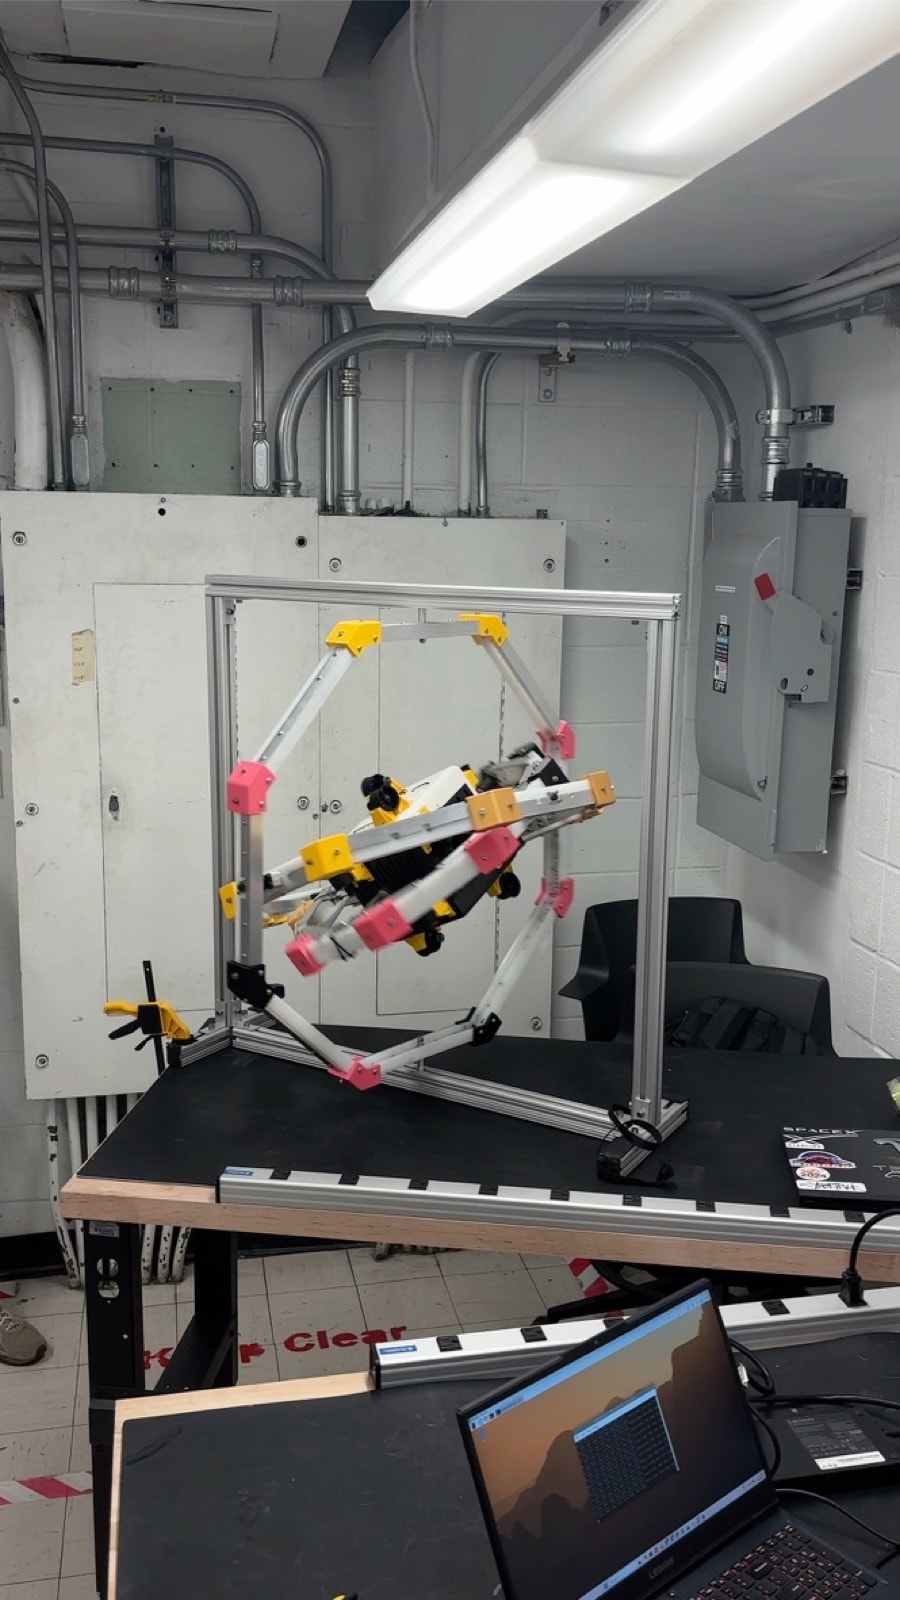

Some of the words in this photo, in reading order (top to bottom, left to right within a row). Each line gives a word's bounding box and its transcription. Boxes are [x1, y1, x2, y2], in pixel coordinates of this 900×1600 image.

[714, 680, 725, 691] OFF
[143, 1343, 265, 1369] Kp
[284, 1326, 407, 1352] Clear
